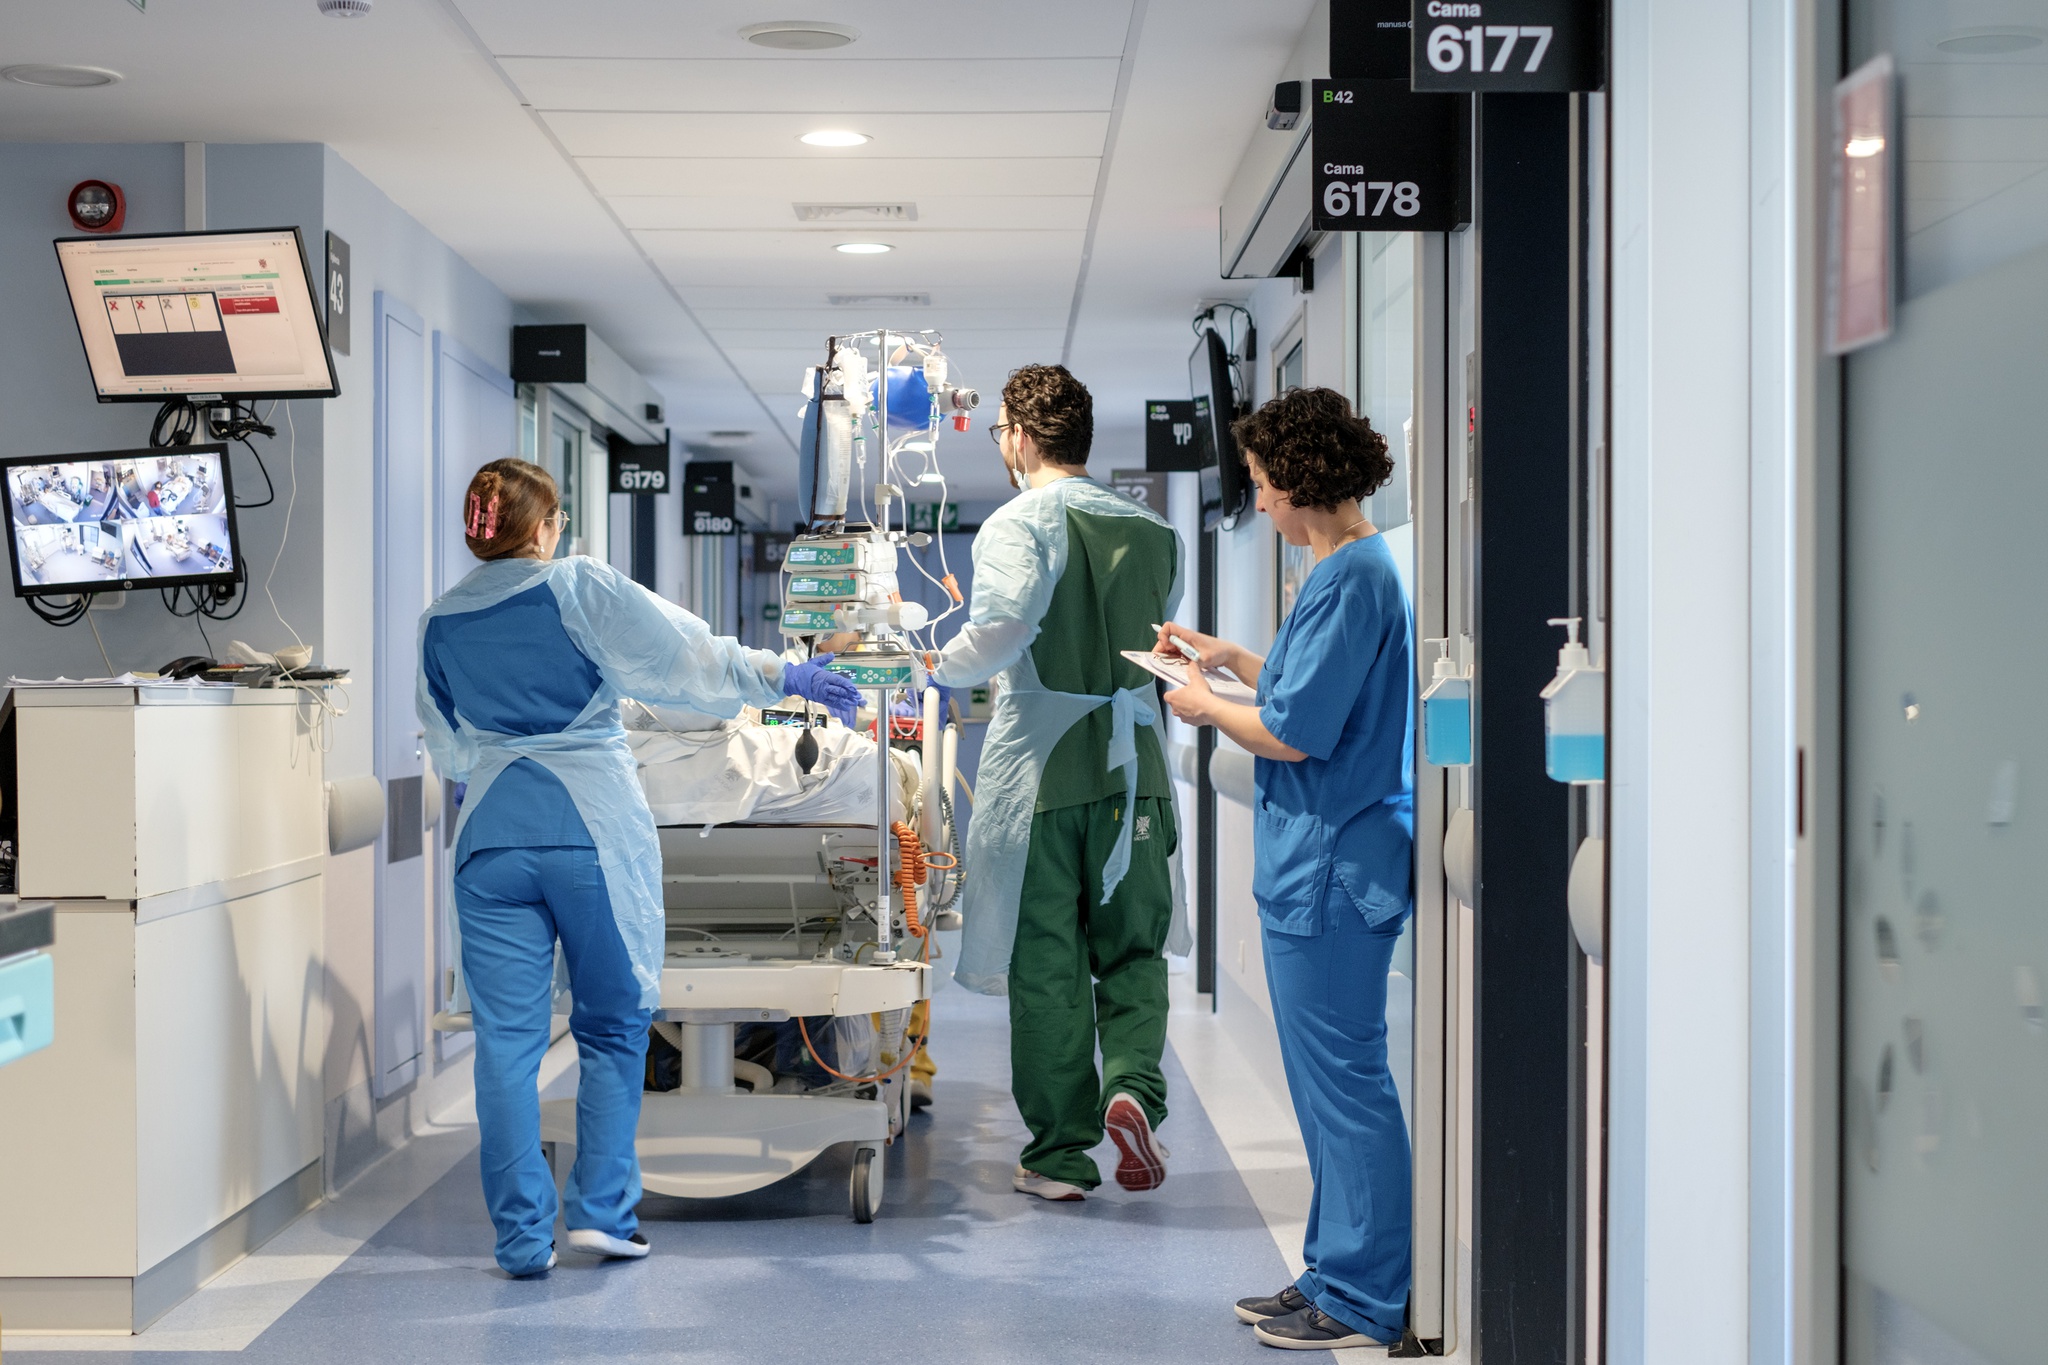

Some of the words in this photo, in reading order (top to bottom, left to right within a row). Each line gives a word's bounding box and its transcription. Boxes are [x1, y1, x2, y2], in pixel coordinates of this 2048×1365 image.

[1427, 1, 1481, 17] Cama
[1426, 25, 1553, 73] 6177
[1323, 90, 1354, 104] B42
[1323, 162, 1364, 175] Cama
[1323, 181, 1421, 217] 6178
[330, 270, 344, 315] 43
[620, 471, 665, 489] 6179
[694, 517, 733, 532] 6180
